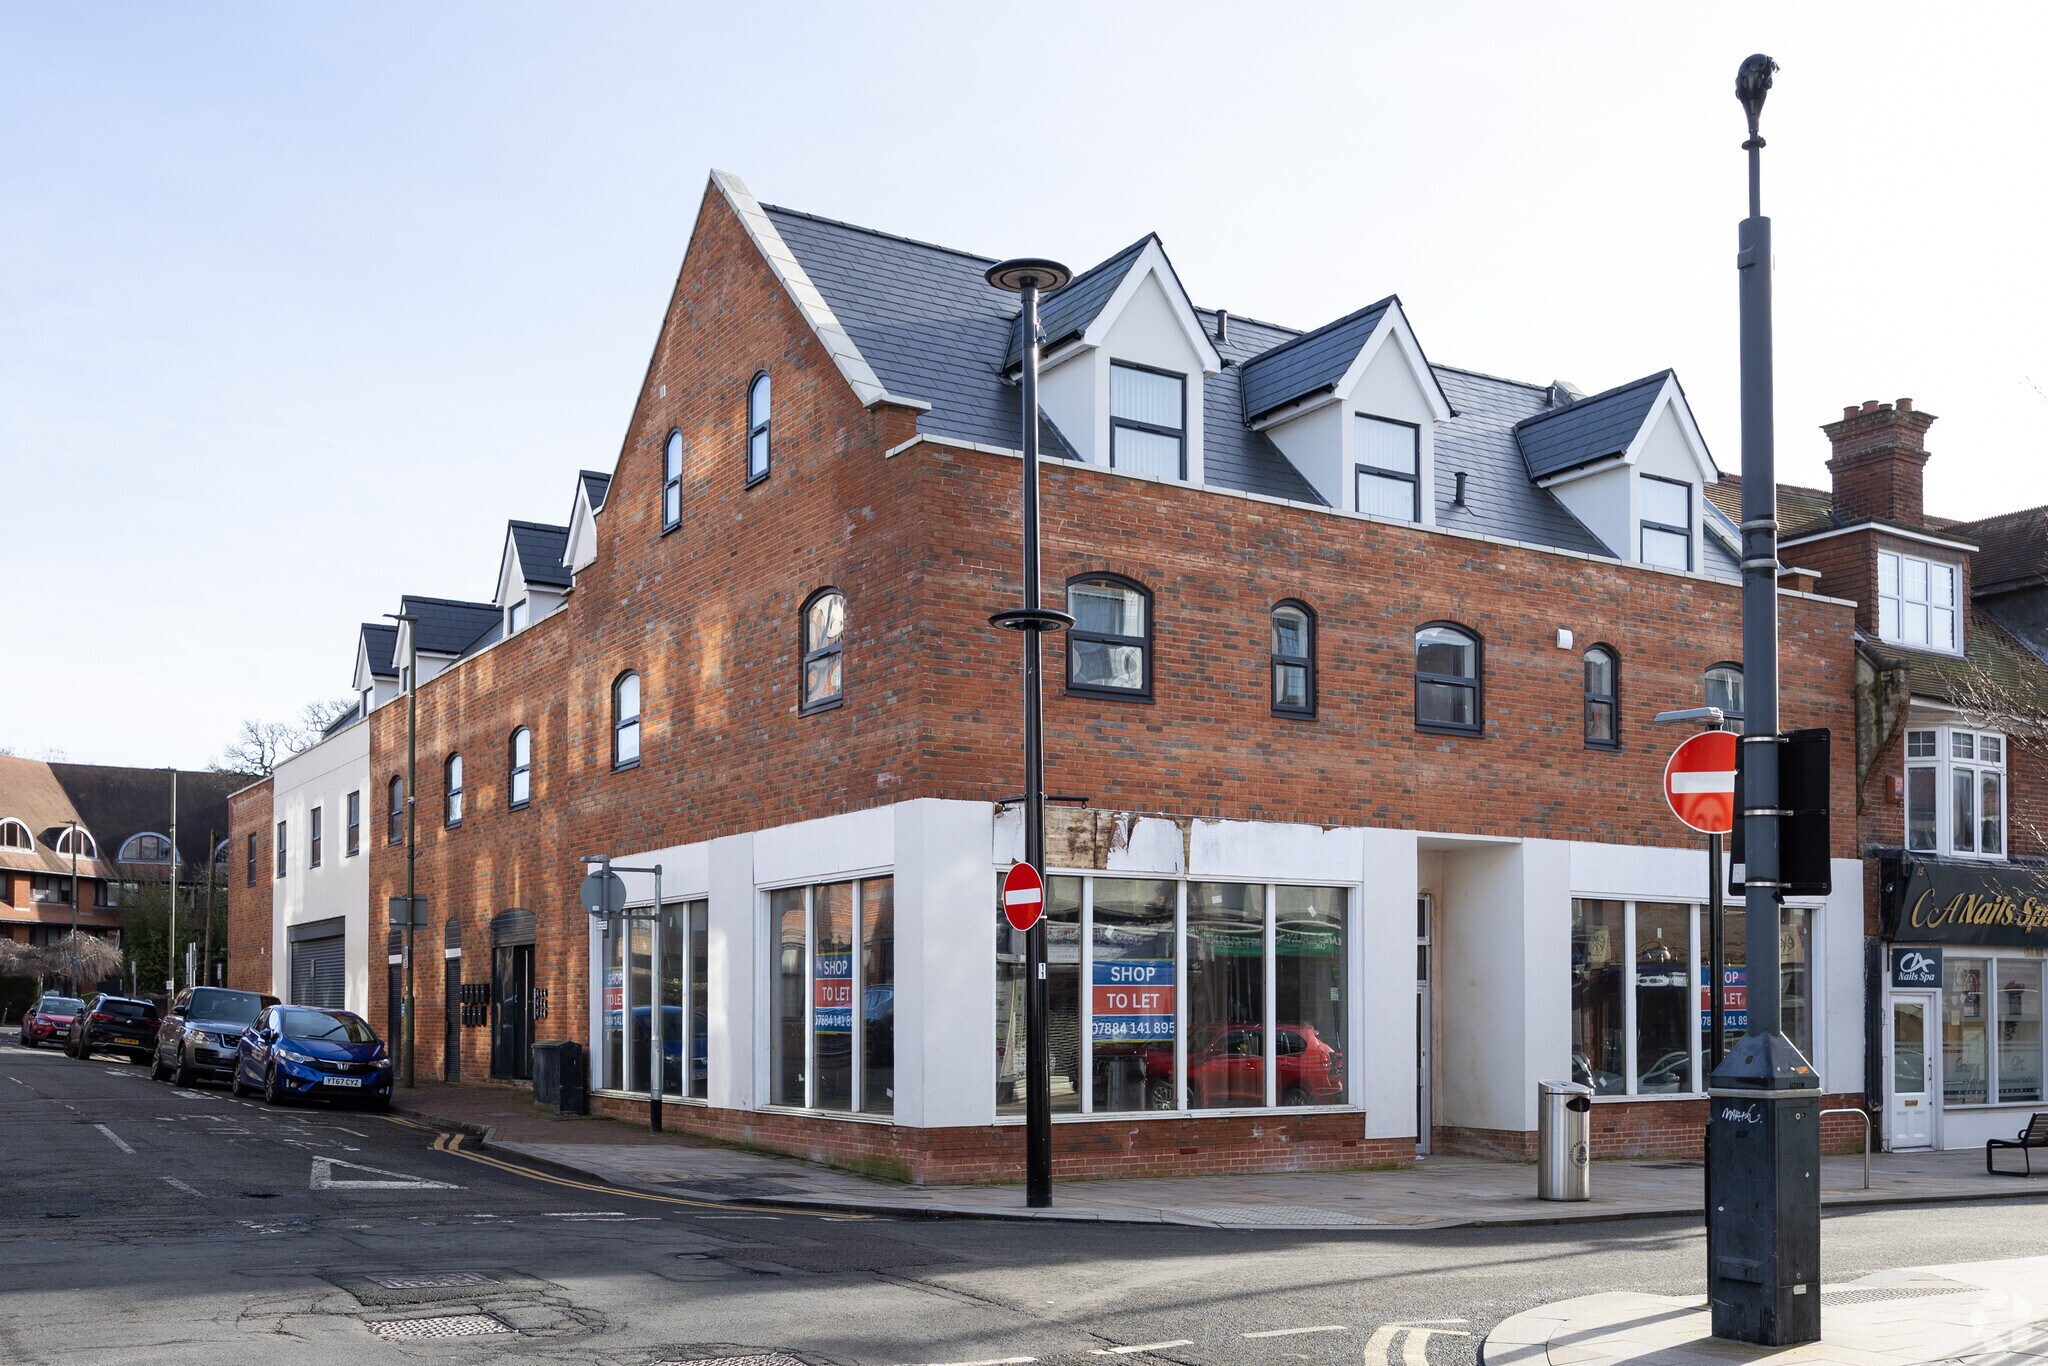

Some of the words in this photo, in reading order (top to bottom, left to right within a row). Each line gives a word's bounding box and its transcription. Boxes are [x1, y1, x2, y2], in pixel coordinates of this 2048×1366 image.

[1917, 866, 1924, 876] 15
[1958, 894, 2016, 926] Nails
[824, 960, 848, 975] SHOP
[1111, 966, 1156, 982] SHOP
[1898, 971, 1918, 981] Nails
[1919, 971, 1935, 983] Spa
[606, 993, 613, 1006] TO
[822, 986, 833, 1001] TO
[835, 986, 850, 1001] LET
[1724, 992, 1742, 1005] LET
[1106, 993, 1128, 1009] TO
[1132, 993, 1160, 1009] LET
[833, 1014, 845, 1027] 141
[1724, 1016, 1737, 1026] 141
[1092, 1022, 1128, 1035] 07884
[1130, 1022, 1151, 1034] 141
[1153, 1022, 1174, 1034] 895
[326, 1077, 344, 1085] YT67
